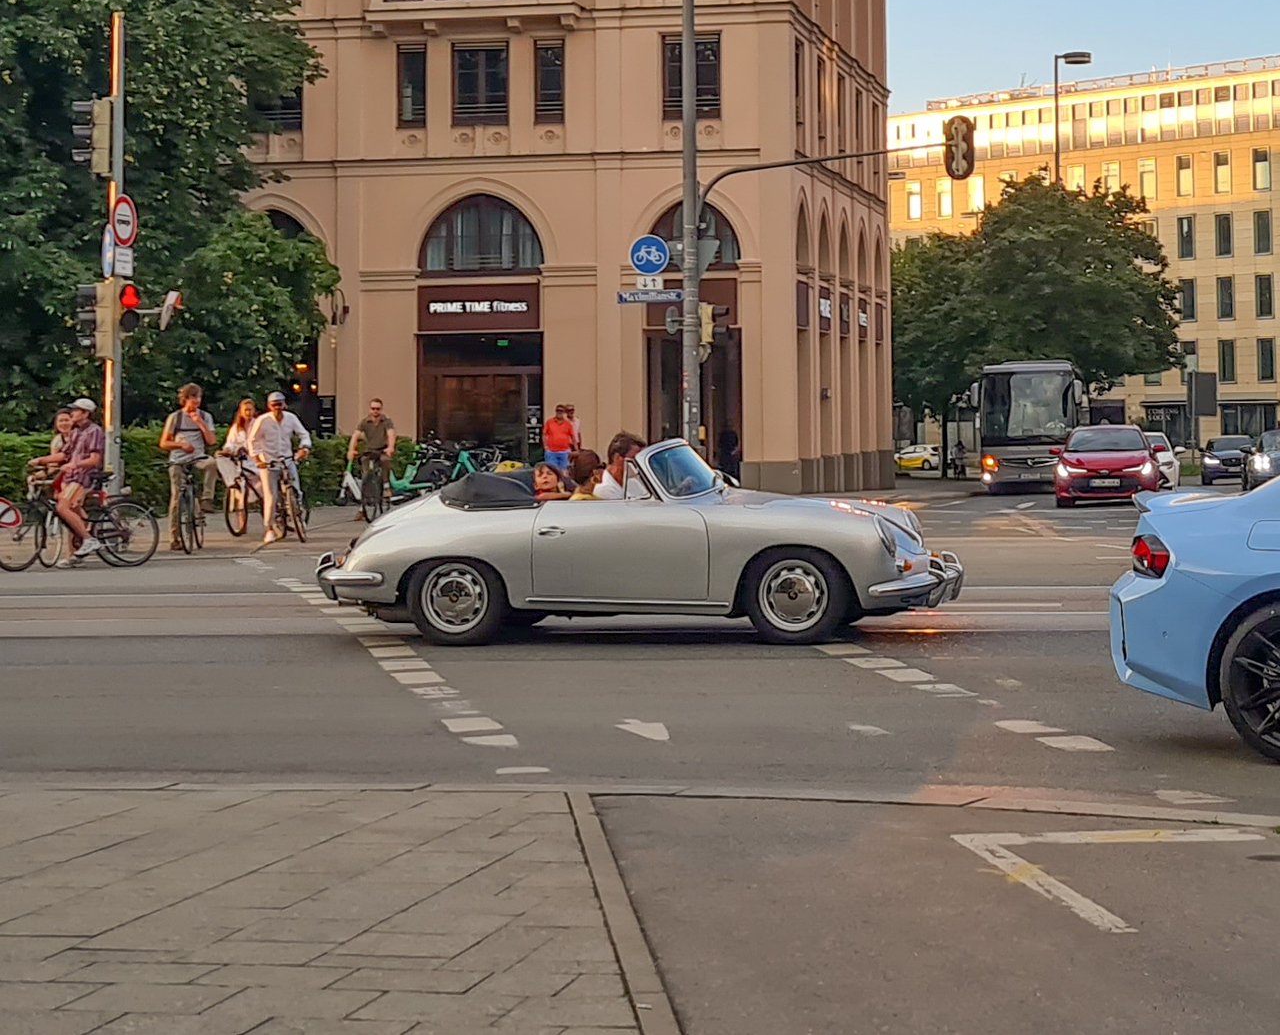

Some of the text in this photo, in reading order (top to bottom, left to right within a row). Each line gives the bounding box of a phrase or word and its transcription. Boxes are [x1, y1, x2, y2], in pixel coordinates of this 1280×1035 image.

[429, 299, 528, 313] PRIME TIME fitness
